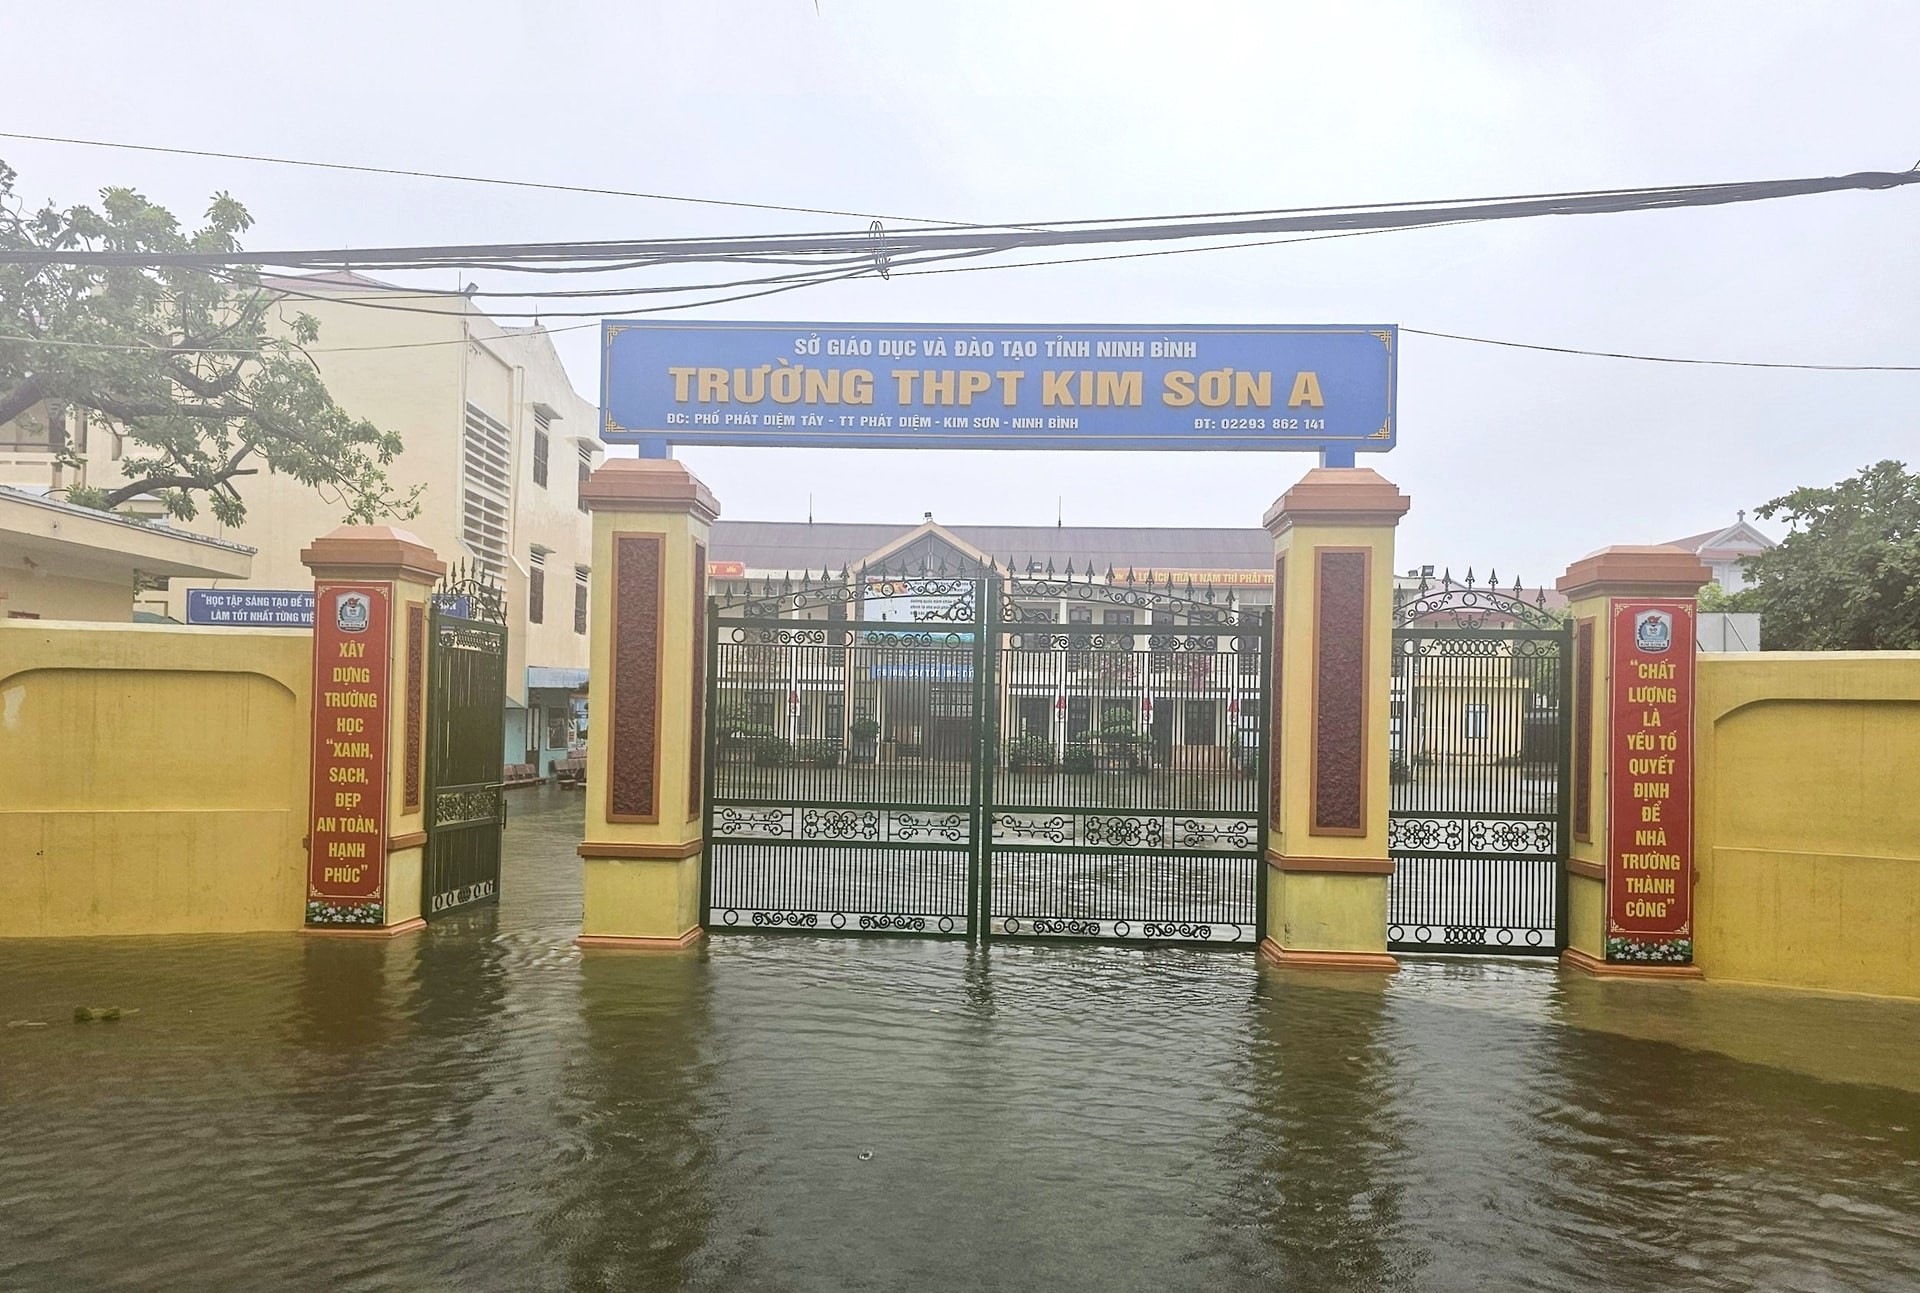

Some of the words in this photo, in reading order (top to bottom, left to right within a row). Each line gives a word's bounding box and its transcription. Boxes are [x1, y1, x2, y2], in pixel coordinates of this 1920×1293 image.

[794, 332, 821, 355] SỞ
[827, 336, 872, 356] GIÁO
[878, 339, 917, 360] DỤC
[923, 336, 947, 357] VÀ
[954, 336, 994, 357] ĐÀO
[1000, 340, 1037, 361] TẠO
[1044, 335, 1090, 358] TỈNH
[1096, 341, 1145, 358] NINH
[1150, 337, 1197, 358] BÌNH
[668, 357, 874, 405] TRƯỜNG
[891, 370, 1025, 406] THPT
[1042, 371, 1143, 406] KIM
[1162, 367, 1272, 407] SƠN
[1287, 371, 1325, 407] A
[666, 413, 690, 424] ĐC:
[694, 410, 721, 424] PHỐ
[725, 412, 758, 425] PHÁT
[764, 412, 795, 428] DIỆM
[801, 413, 824, 426] TÂY
[839, 416, 855, 426] TT
[860, 414, 893, 427] PHÁT
[899, 415, 931, 430] DIỆM
[944, 417, 969, 428] KIM
[973, 417, 1000, 428] SƠN
[1012, 418, 1043, 429] NINH
[1048, 415, 1079, 429] BÌNH
[1194, 419, 1216, 429] ĐT:
[1221, 419, 1266, 429] 02293
[1272, 419, 1298, 429] 862
[1304, 419, 1325, 429] 141
[1200, 572, 1221, 583] NĂM
[1223, 572, 1237, 583] THÌ
[226, 595, 242, 608] TẬP
[245, 595, 270, 607] SÁNG
[271, 597, 288, 608] TẠO
[211, 609, 230, 620] LÀM
[232, 608, 248, 621] TỐT
[250, 609, 274, 621] NHẤT
[275, 610, 299, 622] TỪNG
[339, 640, 365, 658] XÂY
[333, 666, 370, 686] DỰNG
[1629, 658, 1676, 680] “CHẤT
[324, 689, 377, 708] TRƯỜNG
[1628, 686, 1677, 707] LƯỢNG
[336, 717, 364, 736] HỌC
[1643, 708, 1661, 727] LÀ
[326, 738, 374, 760] “XANH,
[1627, 729, 1655, 751] YẾU
[1659, 729, 1677, 751] TỐ
[1629, 754, 1675, 776] QUYẾT
[329, 767, 369, 786] SẠCH,
[335, 792, 361, 811] ĐẸP
[1633, 782, 1670, 802] ĐỊNH
[1641, 800, 1662, 822] ĐỂ
[316, 817, 336, 832] AN
[340, 814, 379, 835] TOÀN,
[1635, 827, 1667, 846] NHÀ
[328, 842, 365, 861] HẠNH
[1621, 850, 1681, 871] TRƯỜNG
[324, 864, 368, 883] PHÚC”
[1626, 874, 1675, 894] THÀNH
[1625, 898, 1675, 918] CÔNG”
